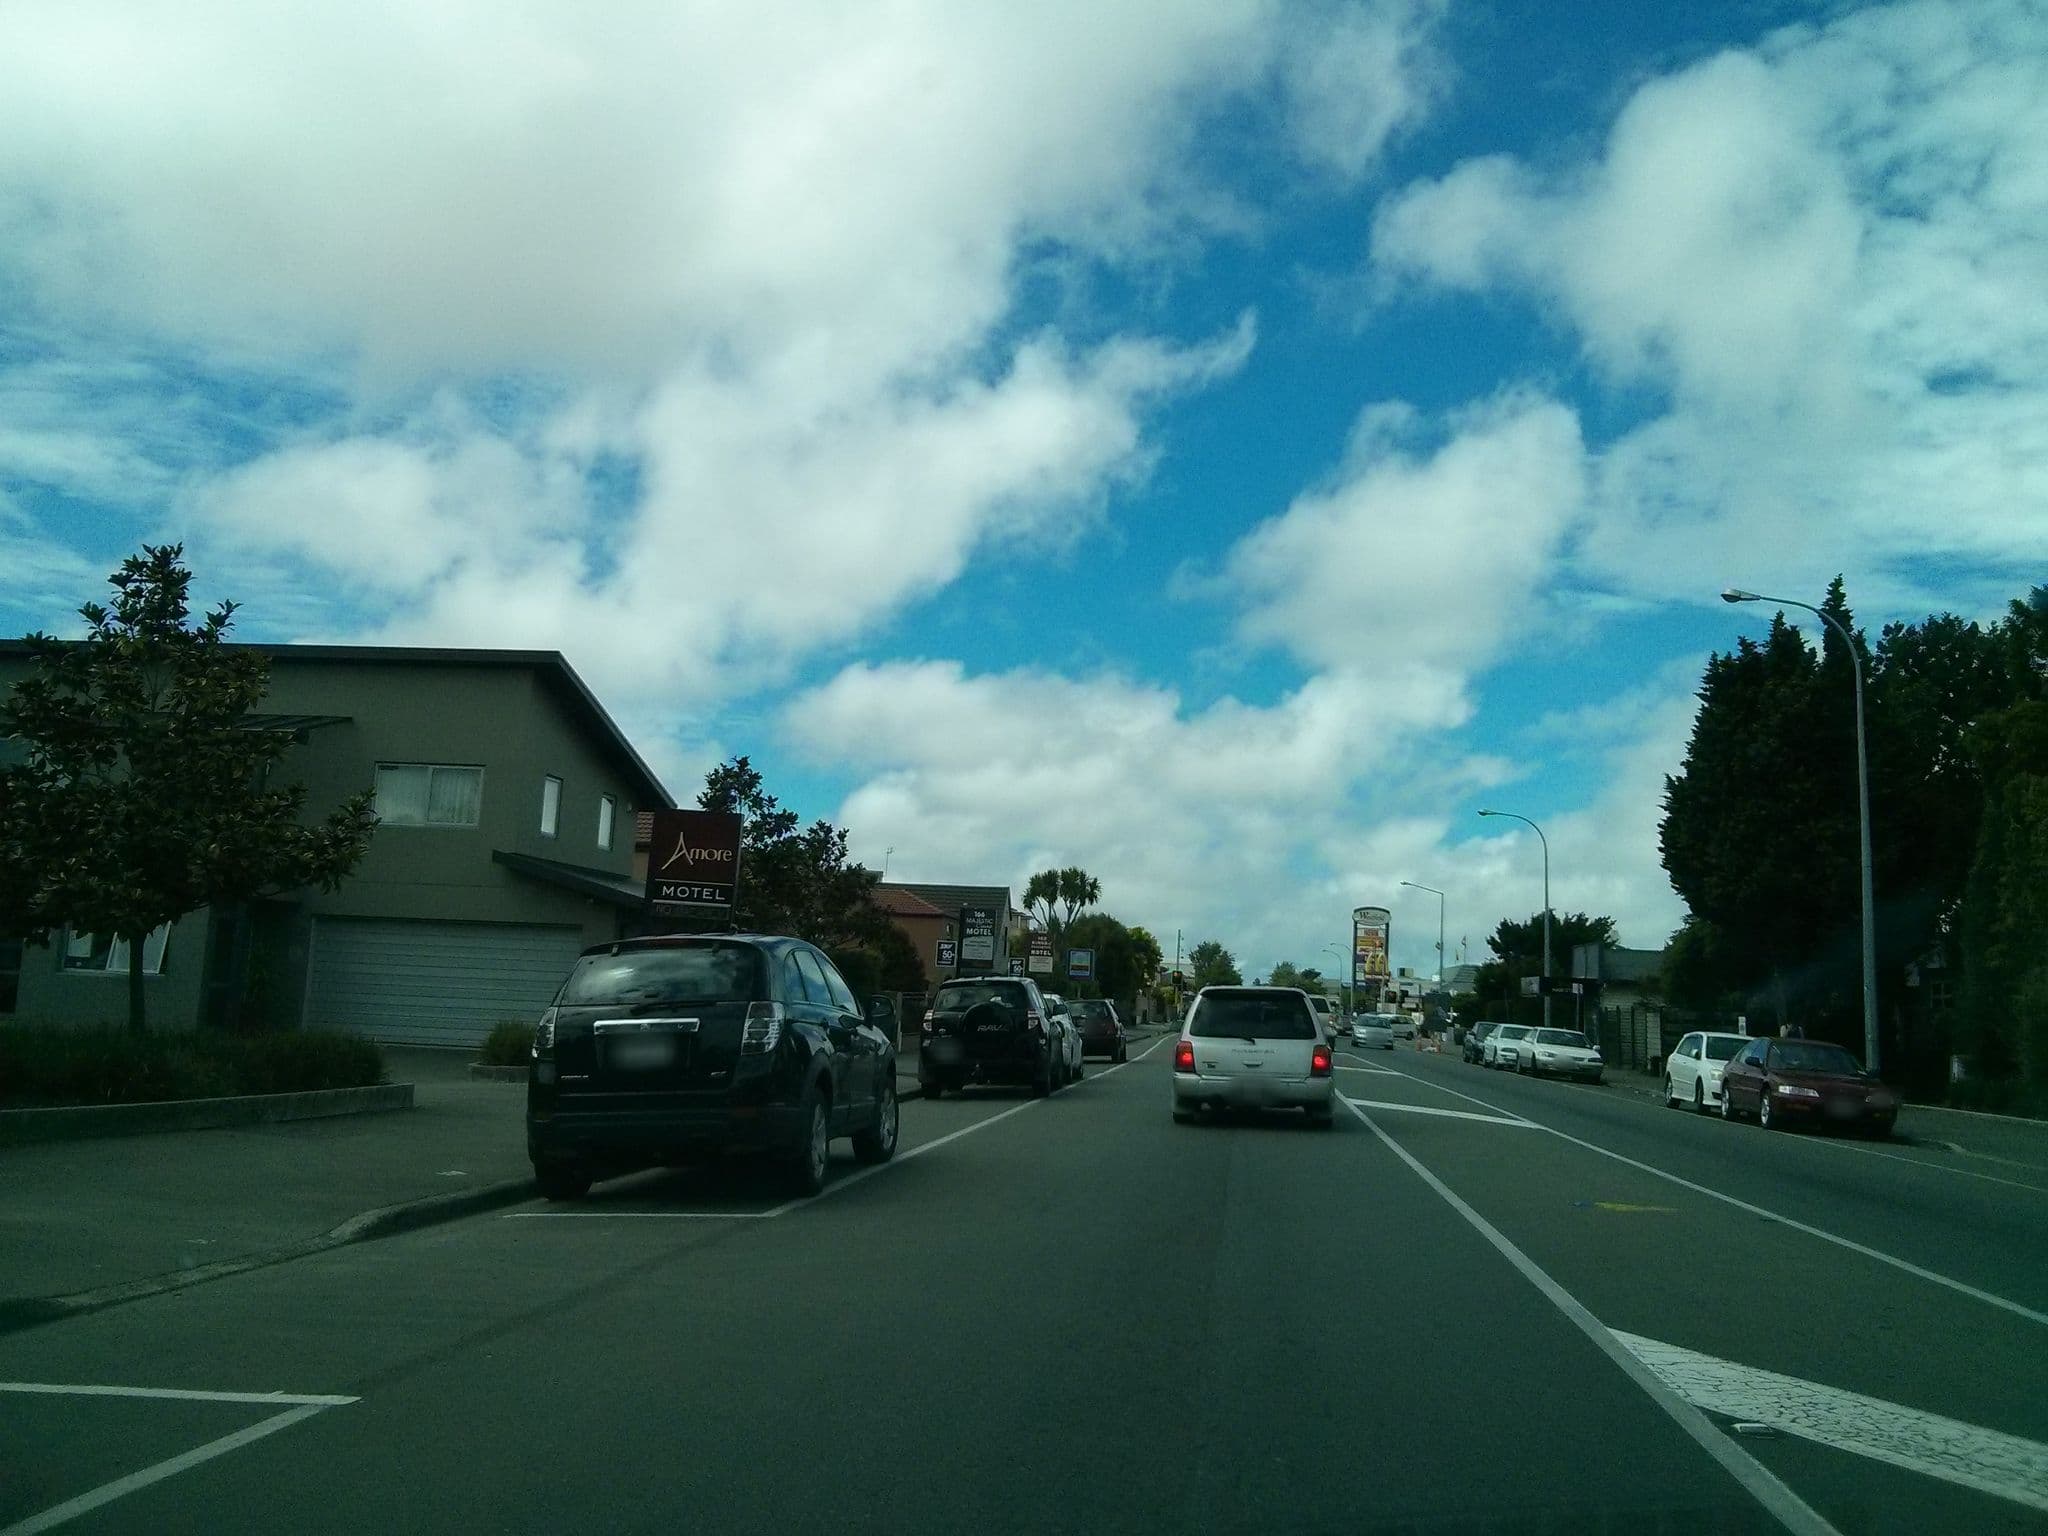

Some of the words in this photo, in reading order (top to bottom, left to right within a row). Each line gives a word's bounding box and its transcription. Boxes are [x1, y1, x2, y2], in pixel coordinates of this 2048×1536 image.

[661, 831, 733, 870] Amore
[662, 885, 726, 900] MOTEL
[966, 927, 993, 936] MOTEL
